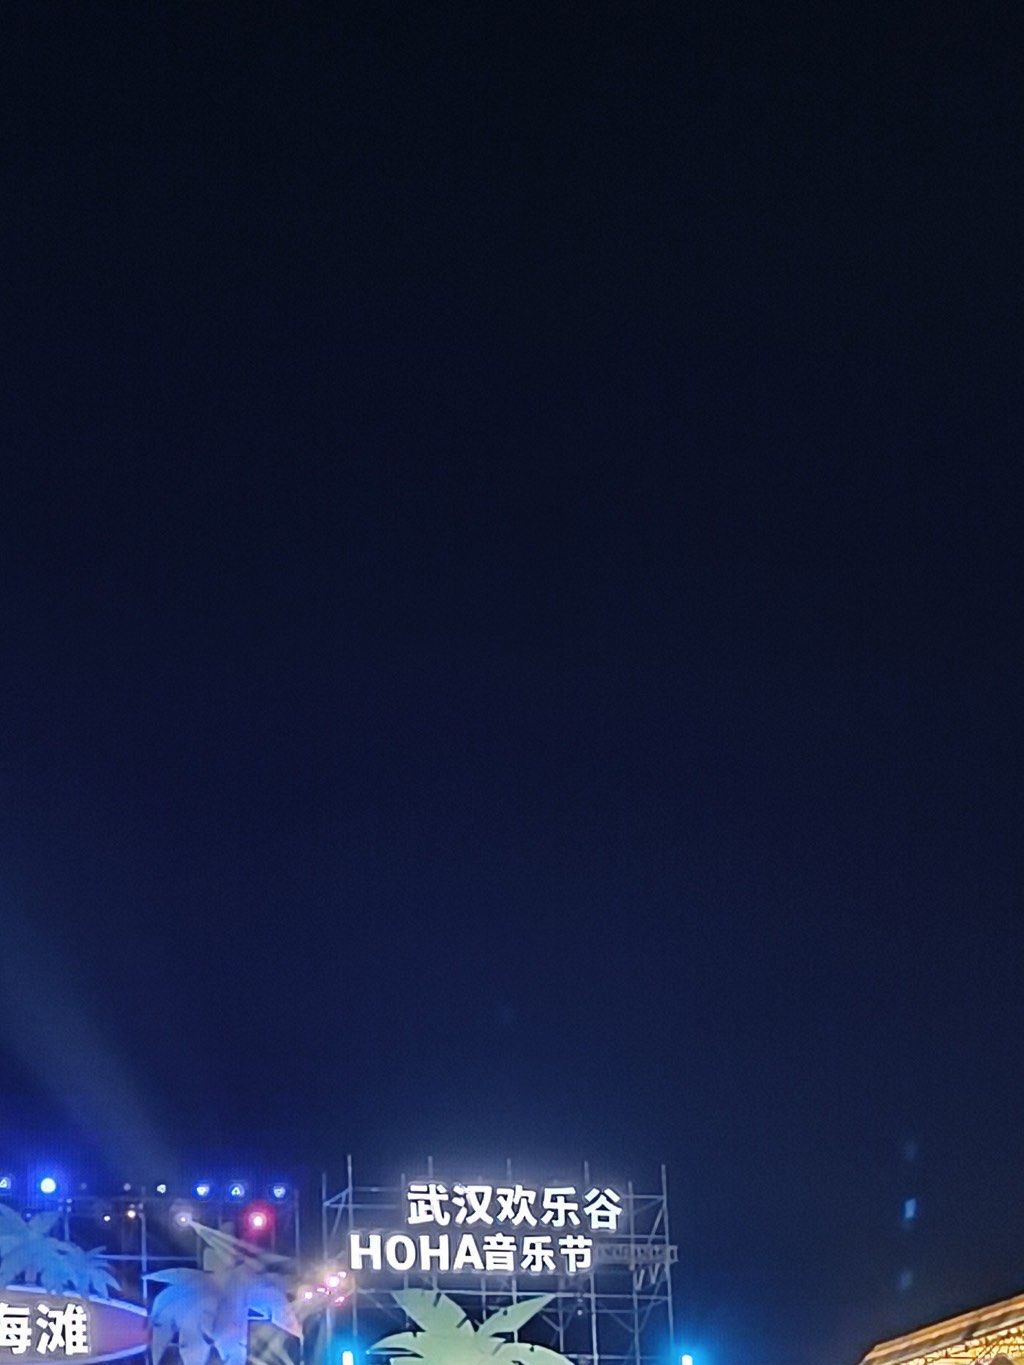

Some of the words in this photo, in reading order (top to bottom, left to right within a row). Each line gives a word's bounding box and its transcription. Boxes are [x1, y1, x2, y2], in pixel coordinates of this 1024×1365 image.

[407, 1184, 624, 1231] 武汉欢乐谷
[349, 1233, 593, 1273] HOHA音乐节
